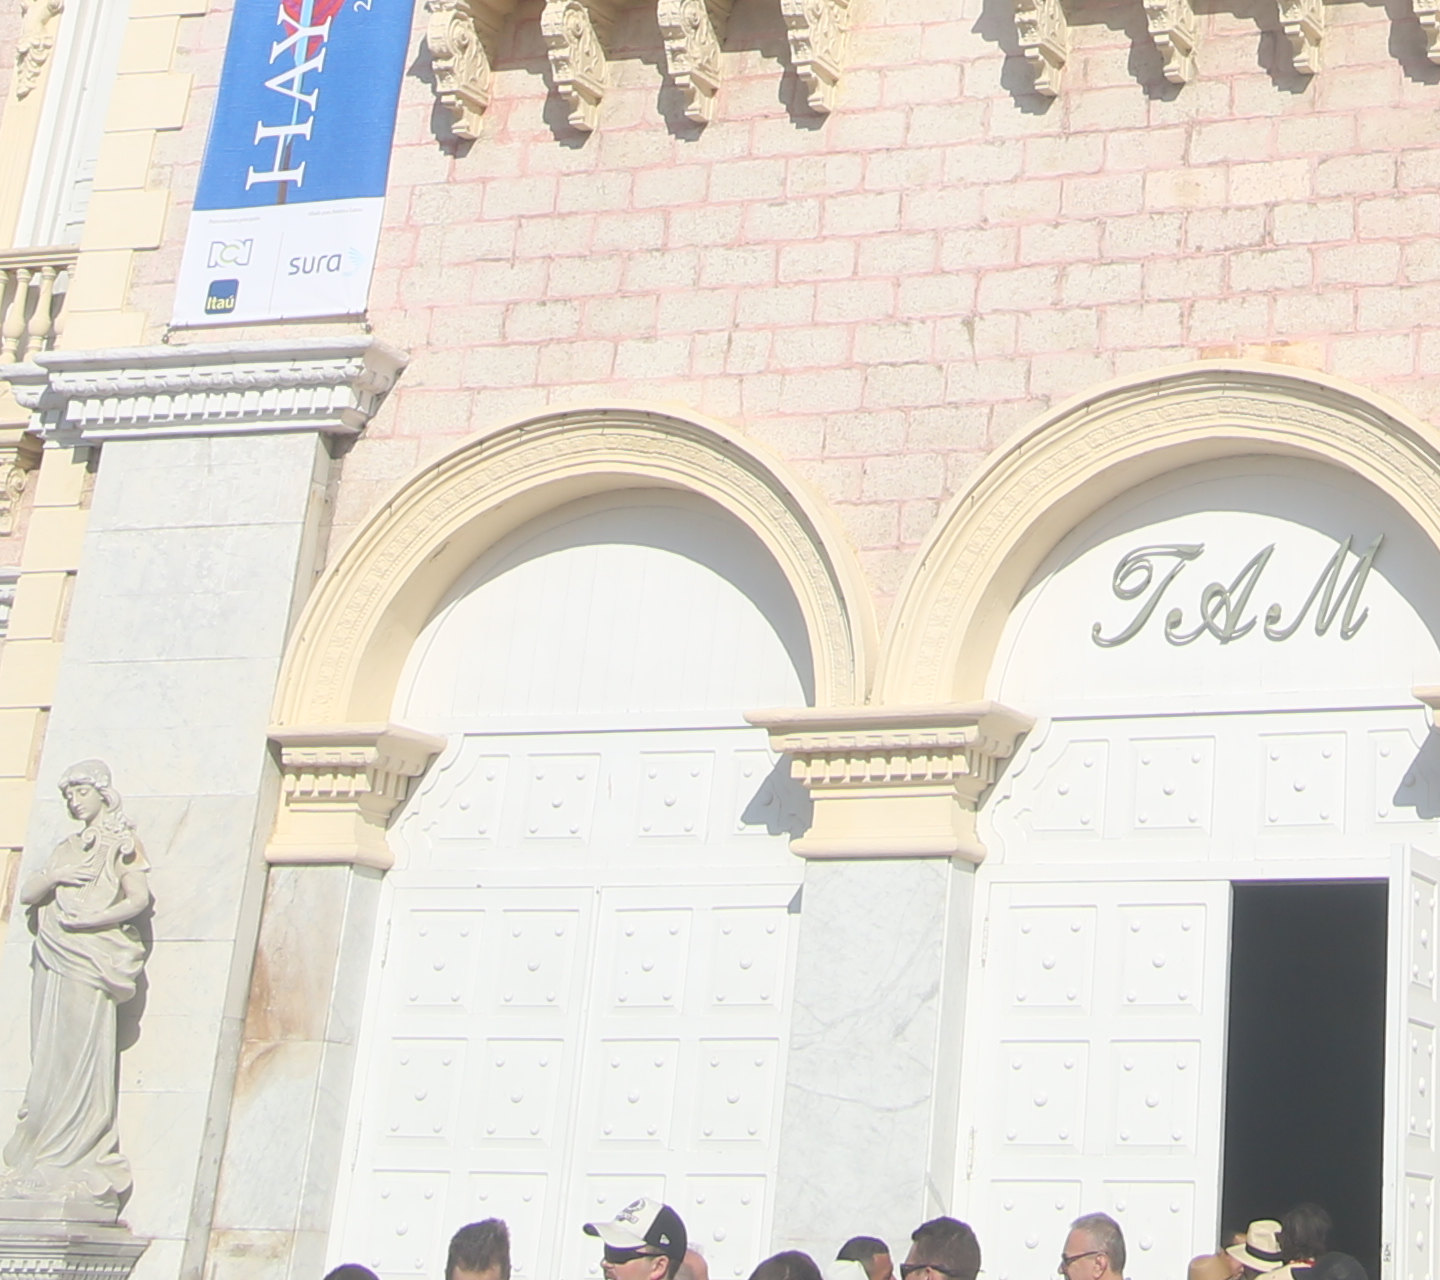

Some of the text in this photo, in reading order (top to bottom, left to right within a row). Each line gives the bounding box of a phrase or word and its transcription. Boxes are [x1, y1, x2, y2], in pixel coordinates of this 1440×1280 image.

[246, 16, 332, 190] HAY
[288, 253, 342, 276] sura
[206, 295, 235, 311] Itaú
[1091, 533, 1385, 648] TAM
